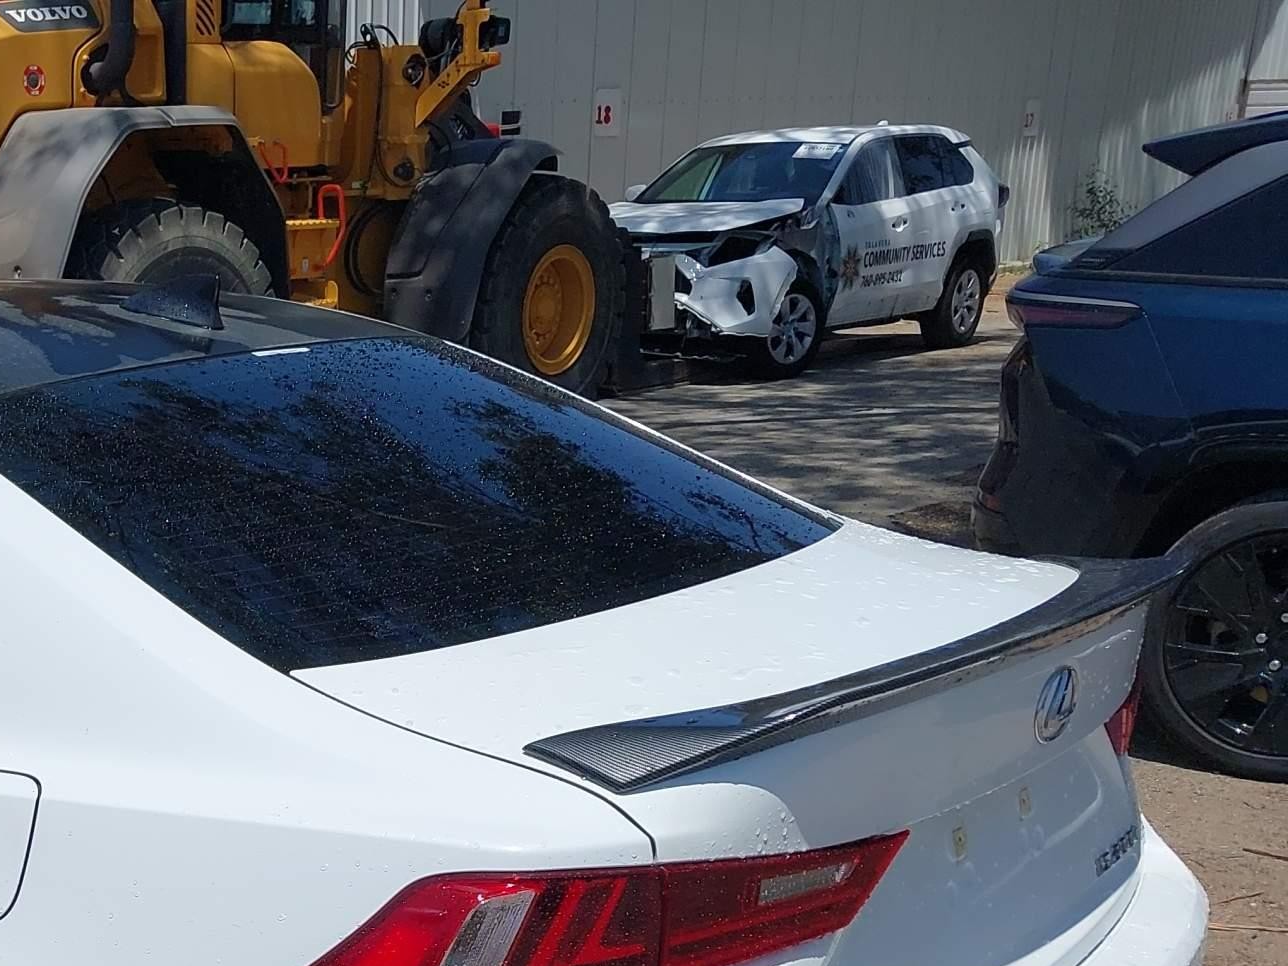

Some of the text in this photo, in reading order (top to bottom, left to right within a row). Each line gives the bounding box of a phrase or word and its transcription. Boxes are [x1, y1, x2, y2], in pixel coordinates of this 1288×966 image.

[5, 5, 88, 23] VOLVO
[595, 104, 612, 125] 18
[863, 241, 947, 269] COMMUNITY SERVICES
